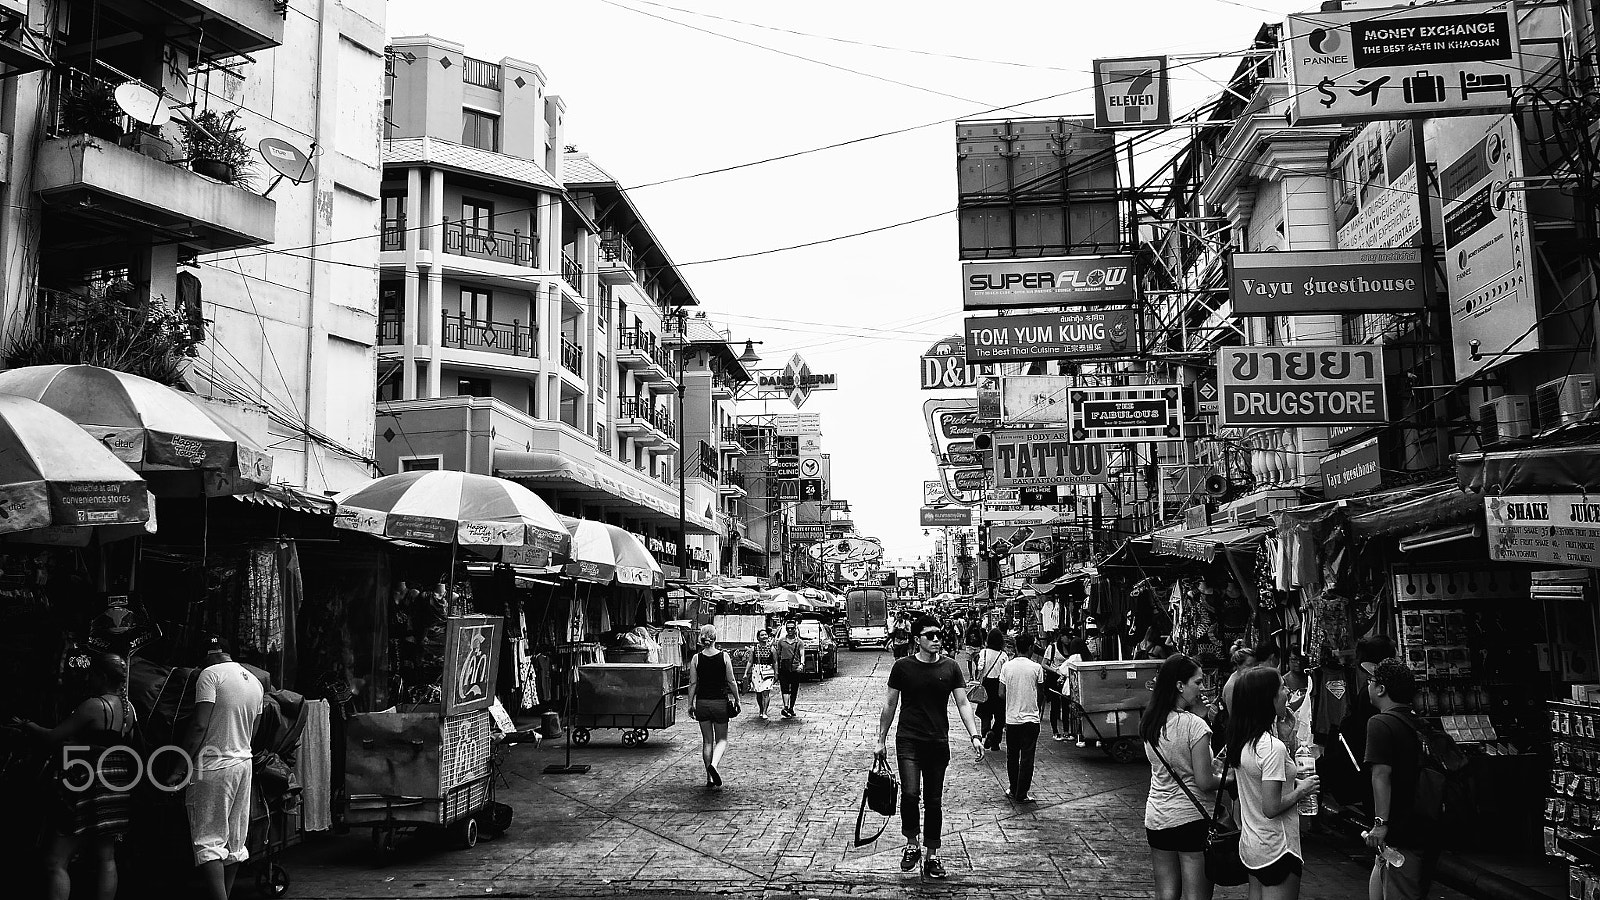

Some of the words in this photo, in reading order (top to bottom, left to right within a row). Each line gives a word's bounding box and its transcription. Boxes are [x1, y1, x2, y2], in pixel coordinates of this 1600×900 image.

[1364, 27, 1416, 41] MONEY
[1420, 23, 1496, 38] EXCHANGE
[1362, 46, 1381, 55] THE
[1383, 44, 1405, 54] BEST
[1407, 42, 1432, 52] RATE
[1433, 41, 1446, 51] IN
[1448, 38, 1500, 50] KHAOSAN
[1303, 55, 1348, 66] PANNEE
[1399, 166, 1416, 190] HOME
[969, 268, 1128, 291] SUPERFLOW
[1241, 278, 1294, 299] Vayu
[1303, 276, 1416, 296] guesthouse
[970, 327, 1009, 347] TOM
[1014, 325, 1053, 344] YUM
[1058, 323, 1105, 342] KUNG
[975, 348, 991, 357] The
[992, 347, 1011, 356] Best
[1011, 346, 1029, 355] Thai
[1030, 345, 1060, 354] Cuisine
[1232, 351, 1374, 381] ขายยา
[799, 374, 835, 385] DERM
[1233, 390, 1376, 415] DRUGSTORE
[1091, 409, 1160, 420] FABULOUS
[170, 434, 202, 452] Happy
[1027, 433, 1051, 441] BODY
[114, 439, 134, 449] dtac
[174, 446, 207, 460] Tourist
[997, 441, 1103, 478] TATTOO
[1030, 476, 1064, 484] TATTOO
[1063, 475, 1091, 483] GROUP
[69, 483, 99, 492] Available
[106, 484, 121, 493] any
[805, 486, 816, 495] 24
[62, 495, 107, 504] convenience
[107, 495, 131, 503] stores
[8, 502, 26, 512] dtac
[1506, 502, 1550, 521] SHAKE
[1569, 502, 1600, 523] JUICE
[466, 523, 488, 533] Happy
[1523, 527, 1539, 535] SHAKE
